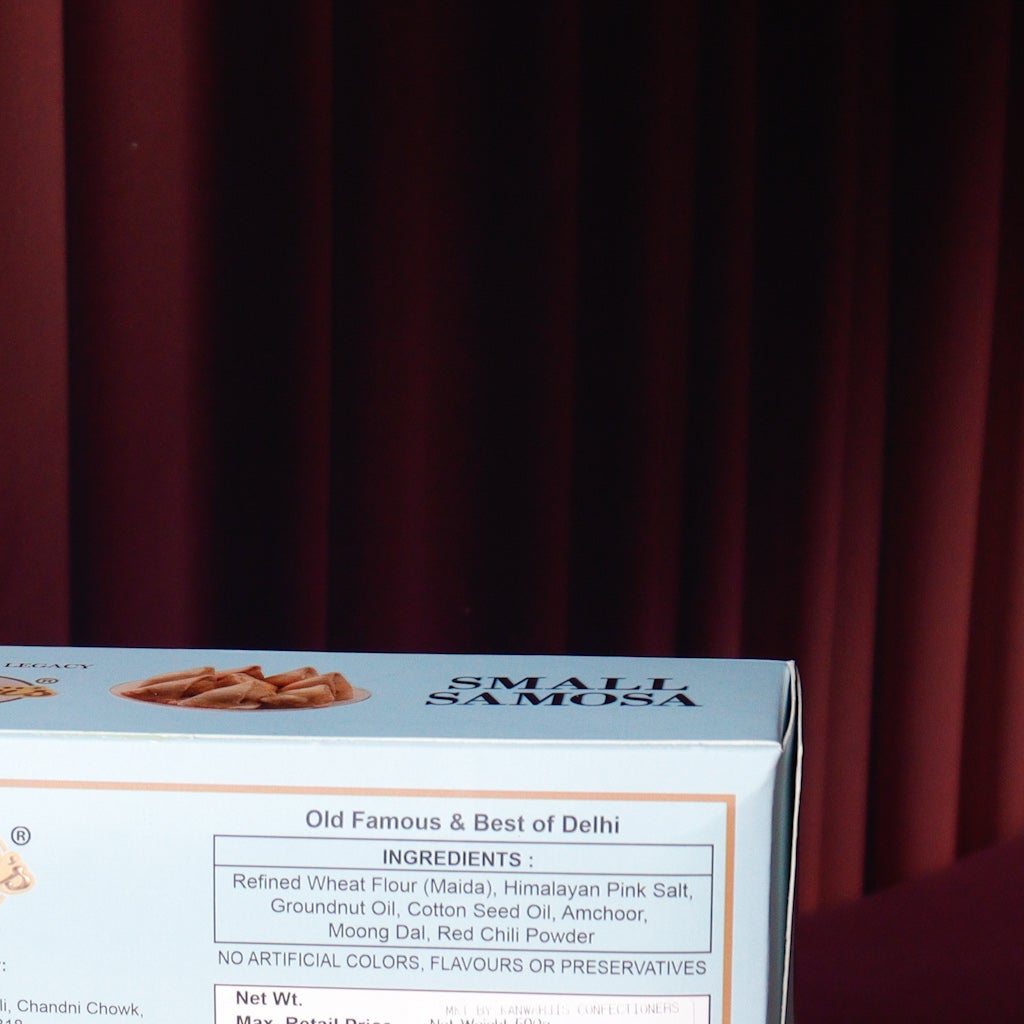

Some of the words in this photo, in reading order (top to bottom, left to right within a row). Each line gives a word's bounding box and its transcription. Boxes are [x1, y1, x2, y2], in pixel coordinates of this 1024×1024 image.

[448, 676, 689, 691] SMALL
[425, 691, 704, 707] SAMOSA
[305, 809, 344, 829] Old
[352, 810, 442, 831] Famous
[449, 812, 465, 831] &
[474, 813, 525, 833] Best
[532, 814, 555, 833] of
[562, 814, 619, 834] Delhi
[383, 848, 521, 868] INGREDIENTS
[232, 872, 301, 891] Refined
[306, 874, 366, 892] Wheat
[372, 876, 418, 894] Flour
[423, 877, 497, 899] (Maida),
[504, 879, 600, 901] Himalayan
[607, 881, 647, 898] Pink
[652, 882, 693, 901] Salt,
[270, 897, 366, 916] Groundnut
[370, 899, 400, 919] Oil,
[407, 900, 467, 918] Cotton
[472, 902, 520, 919] Seed
[526, 903, 556, 923] Oil,
[560, 904, 647, 924] Amchoor,
[328, 922, 389, 944] Moong
[396, 923, 430, 943] Dal,
[437, 924, 474, 942] Red
[480, 925, 519, 943] Chili
[526, 927, 595, 944] Powder
[218, 950, 244, 966] NO
[247, 950, 342, 968] ARTIFICIAL
[346, 952, 424, 972] COLORS,
[430, 955, 524, 973] FLAVOURS
[528, 957, 555, 974] OR
[560, 958, 707, 976] PRESERVATIVES
[16, 999, 81, 1014] Chandni
[86, 1001, 143, 1018] Chowk,
[236, 990, 267, 1006] Net
[272, 991, 302, 1007] Wt.
